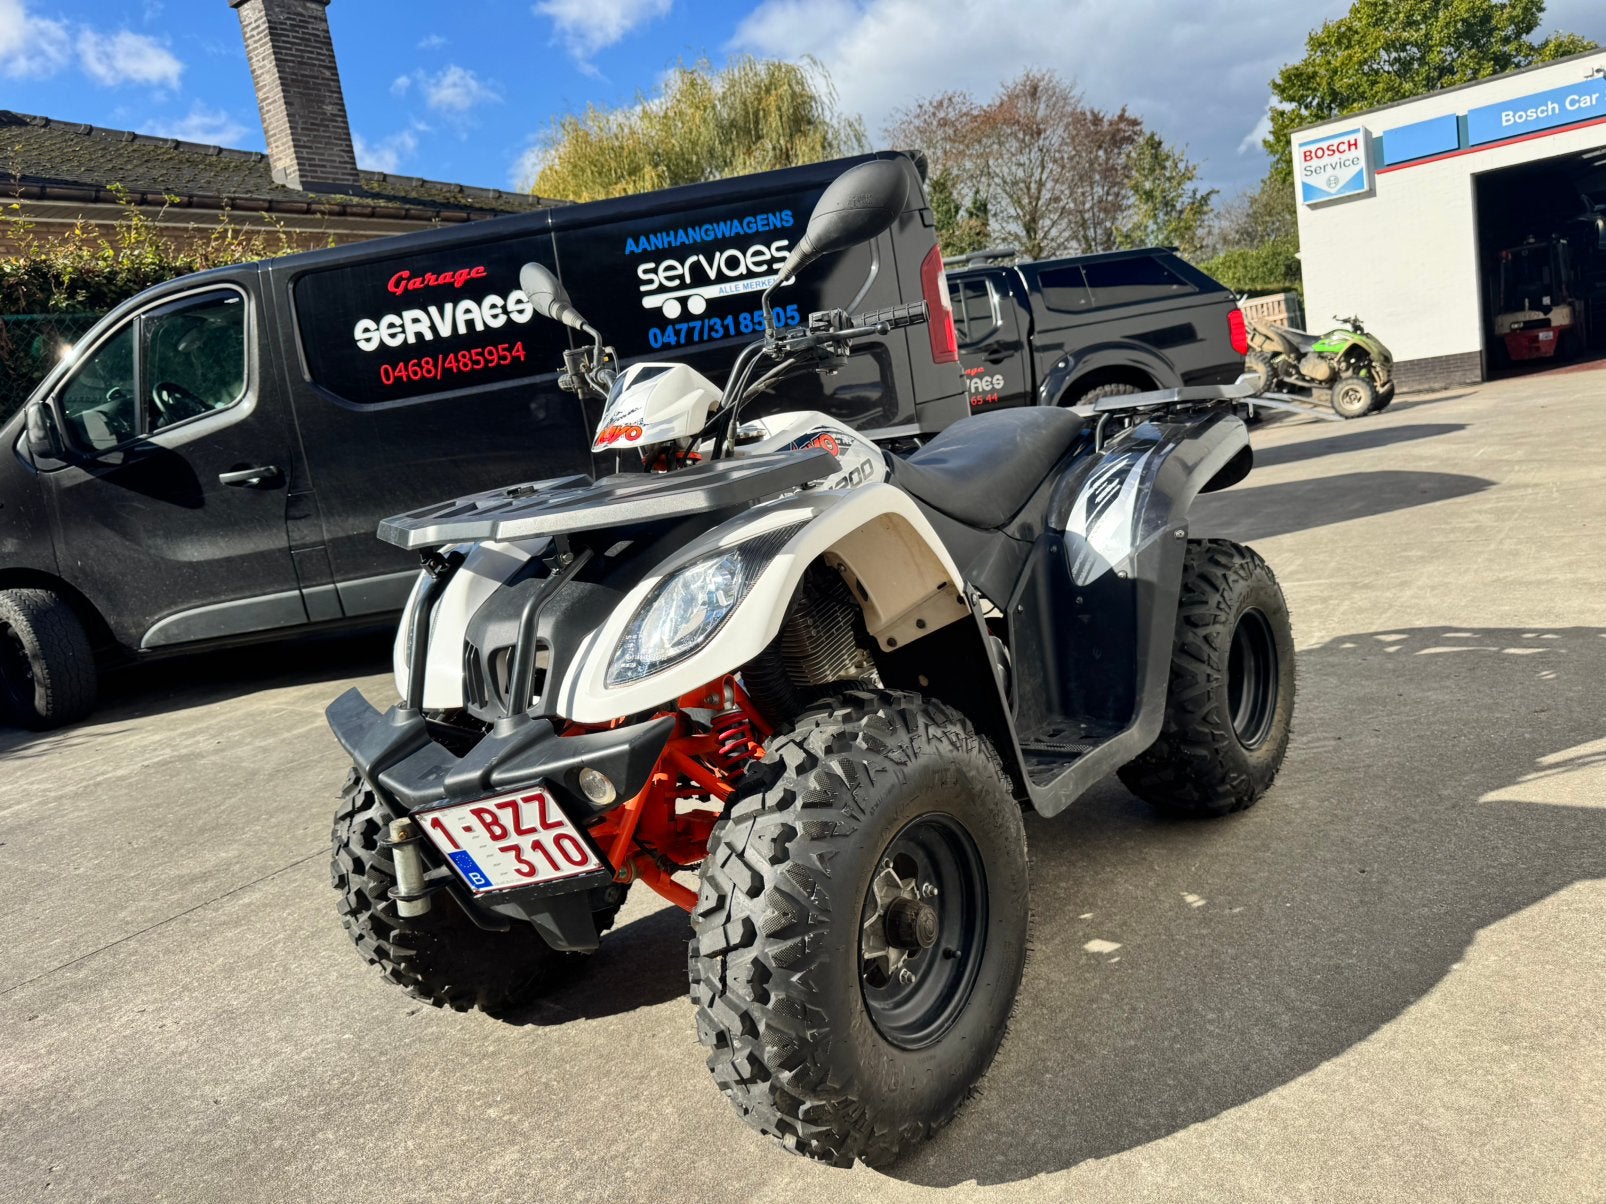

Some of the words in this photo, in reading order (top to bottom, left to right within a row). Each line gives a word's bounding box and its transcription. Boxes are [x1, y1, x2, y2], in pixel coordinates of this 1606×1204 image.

[1501, 101, 1560, 127] Bosch
[1565, 93, 1600, 111] Car
[1303, 138, 1359, 162] BOSCH
[1303, 156, 1360, 177] Service
[625, 209, 794, 255] AANHANGWAGENS
[387, 265, 488, 296] Garage
[637, 239, 792, 292] servaes
[718, 282, 741, 295] ALLE
[353, 289, 534, 352] SERVAES
[380, 341, 526, 385] 0468/485954
[498, 832, 589, 878] 310
